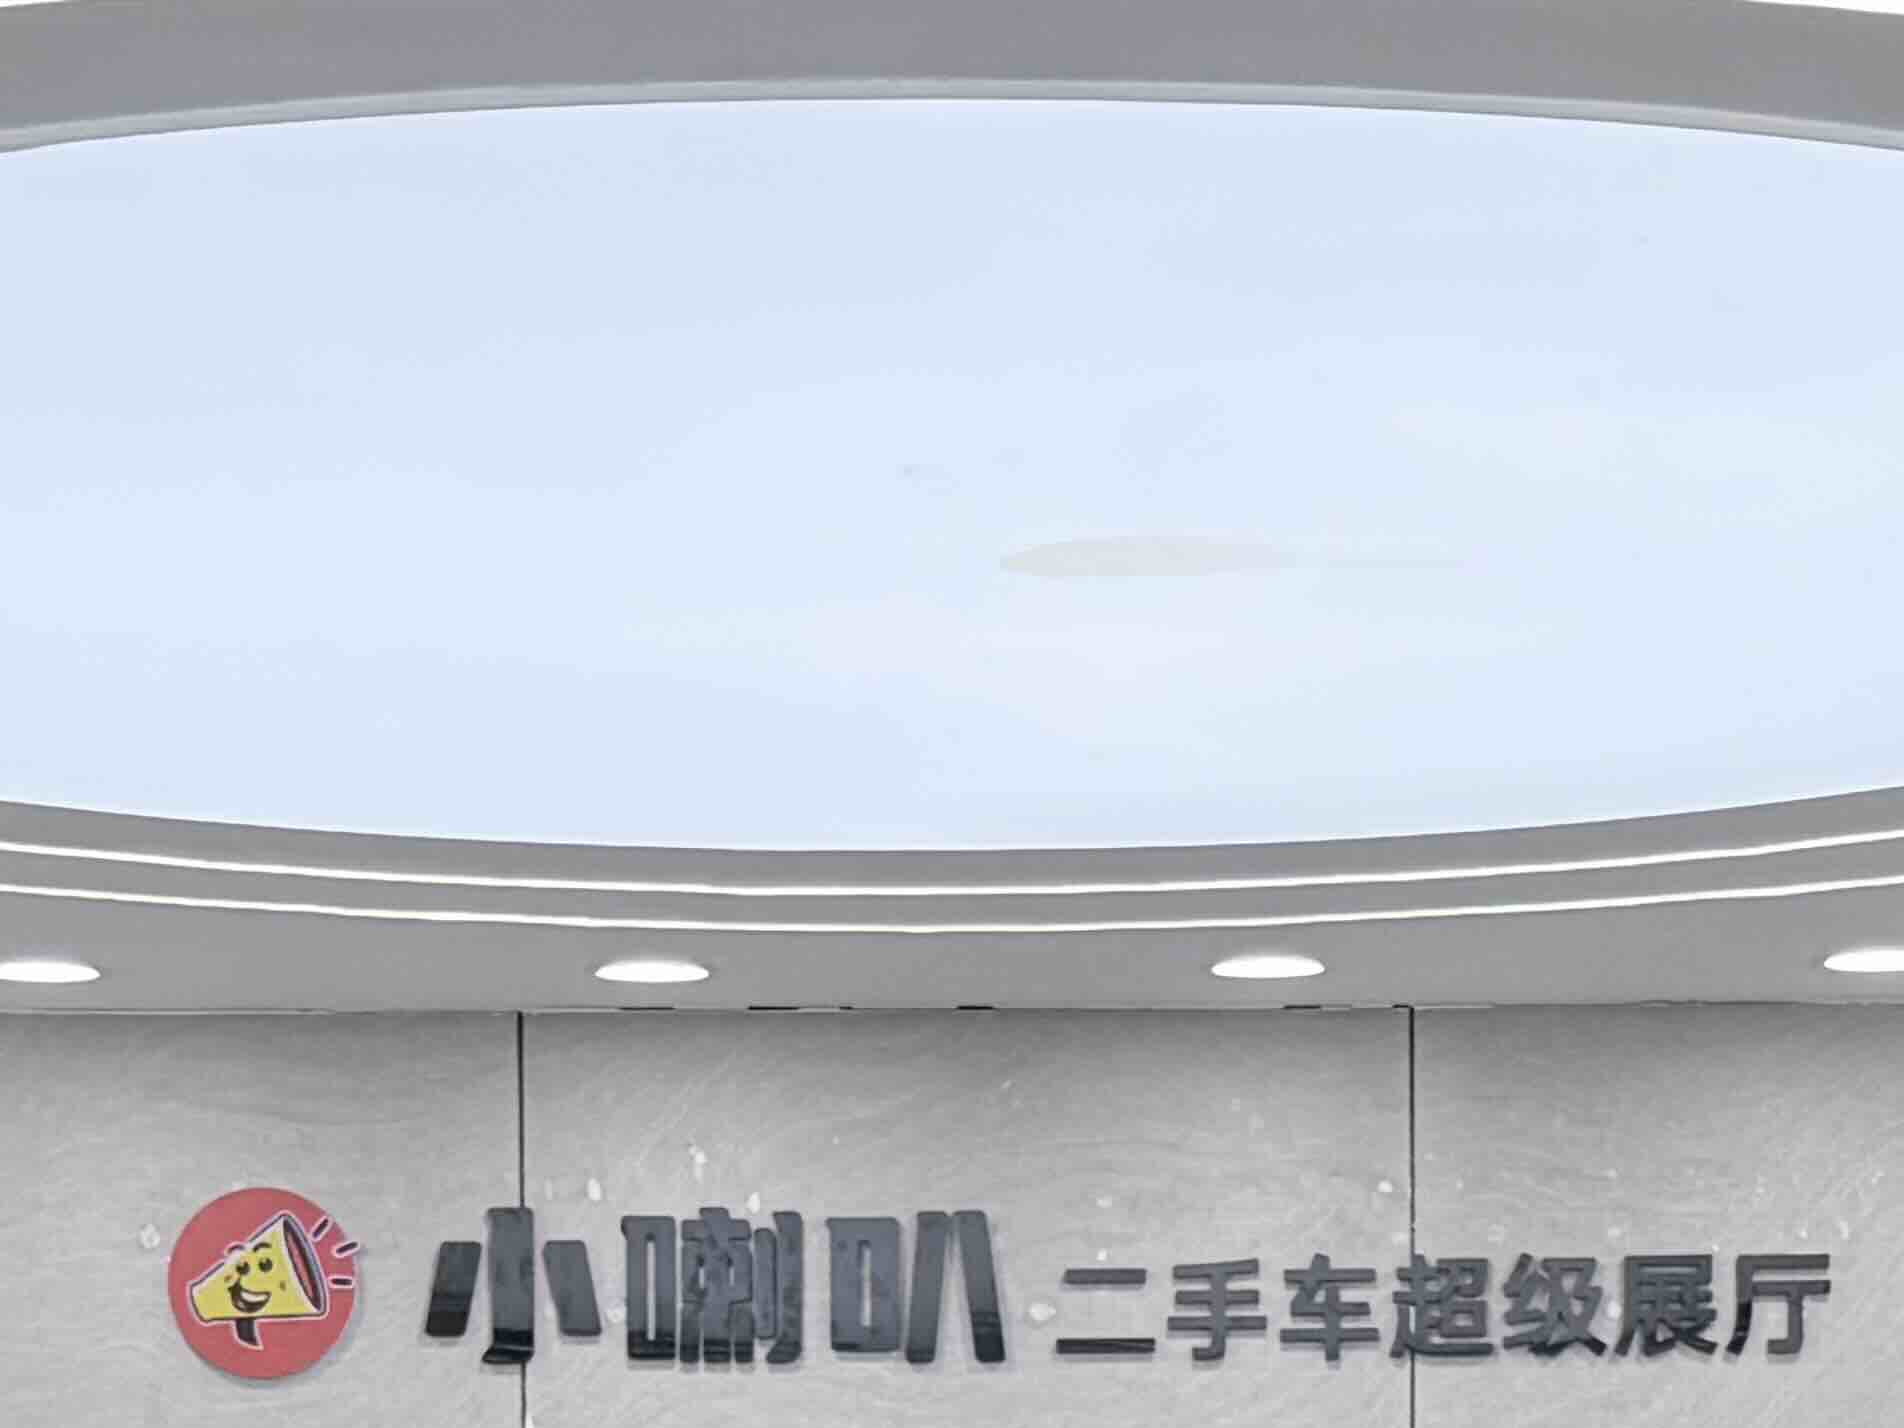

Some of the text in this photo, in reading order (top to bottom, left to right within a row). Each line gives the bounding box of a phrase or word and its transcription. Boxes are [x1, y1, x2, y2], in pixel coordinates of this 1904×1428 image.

[425, 1206, 1832, 1364] 小喇叭 二手车超级展厅
